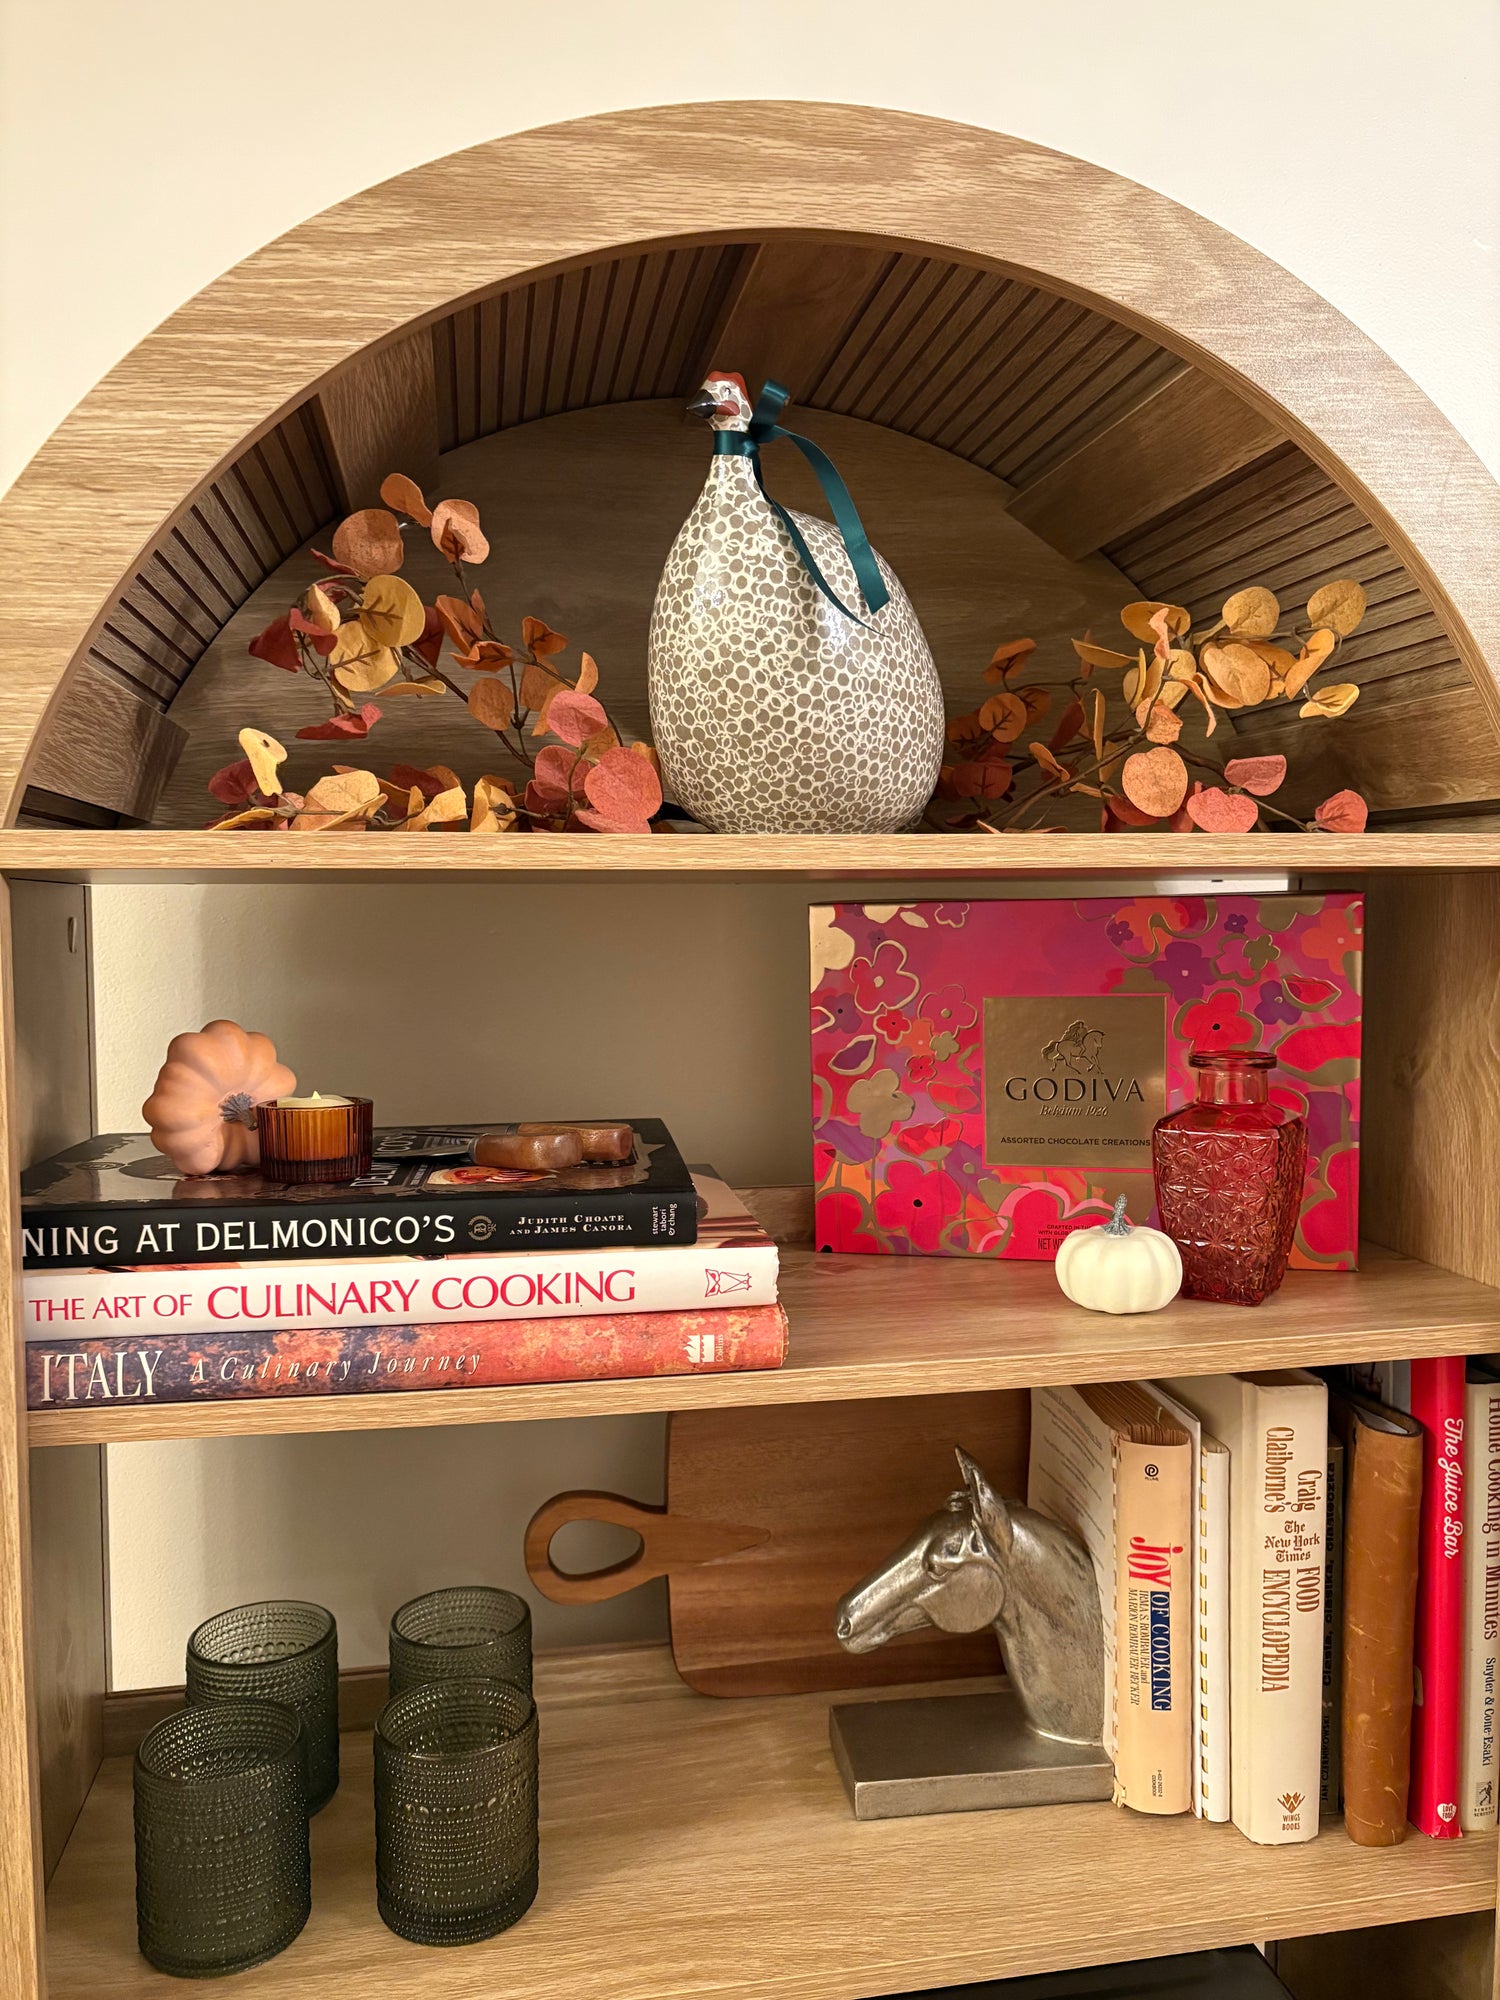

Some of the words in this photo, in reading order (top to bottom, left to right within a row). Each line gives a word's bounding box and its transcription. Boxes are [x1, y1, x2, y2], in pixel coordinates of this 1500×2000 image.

[1004, 1077, 1145, 1102] GODIVA
[1040, 1105, 1082, 1118] Belgium
[1086, 1105, 1108, 1116] 1926
[1000, 1136, 1045, 1145] ASSORTED
[1047, 1137, 1100, 1146] CHOCOLATE
[1101, 1138, 1151, 1147] CREATIONS
[518, 1216, 568, 1225] JUDITH
[574, 1214, 625, 1224] CHOATE
[534, 1225, 577, 1234] JAMES
[583, 1223, 633, 1233] CANORA
[668, 1203, 678, 1226] chang
[136, 1223, 181, 1254] AT
[197, 1214, 456, 1252] DELMONICO'S
[668, 1227, 676, 1236] &
[1038, 1238, 1052, 1250] NET
[29, 1299, 86, 1322] THE
[92, 1296, 147, 1320] ART
[153, 1294, 193, 1317] OF
[207, 1279, 420, 1319] CULINARY
[432, 1269, 636, 1310] COOKING
[716, 1334, 724, 1361] Collins
[41, 1350, 163, 1402] ITALY
[190, 1358, 205, 1382] A
[220, 1355, 351, 1382] Culinary
[368, 1351, 480, 1375] Journey
[1444, 1418, 1464, 1458] The
[1263, 1426, 1295, 1513] Claiborne's
[1291, 1470, 1323, 1513] Craig
[1437, 1457, 1464, 1514] Juice
[1482, 1458, 1500, 1533] Cooking
[1264, 1535, 1291, 1549] New
[1293, 1533, 1320, 1551] York
[1284, 1520, 1306, 1534] The
[1443, 1516, 1464, 1559] Bar
[1275, 1550, 1311, 1563] Times
[1486, 1541, 1500, 1559] in
[1140, 1590, 1149, 1612] IRMA
[1295, 1566, 1321, 1612] FOOD
[1484, 1565, 1500, 1641] Minutes
[1128, 1588, 1138, 1623] MARION
[1151, 1594, 1170, 1618] OF
[1262, 1569, 1290, 1692] ENCYCLOPEDIA
[1129, 1623, 1139, 1671] ROMBAUER
[1140, 1622, 1150, 1671] ROMBAUER
[1141, 1671, 1151, 1684] and
[1151, 1623, 1172, 1710] COOKING
[1482, 1657, 1497, 1694] Snyder
[1130, 1672, 1140, 1706] BECKER
[1484, 1696, 1495, 1706] &
[1482, 1707, 1496, 1767] Cone-Esaki
[1282, 1813, 1301, 1822] WINGS
[1282, 1822, 1301, 1831] BOOKS
